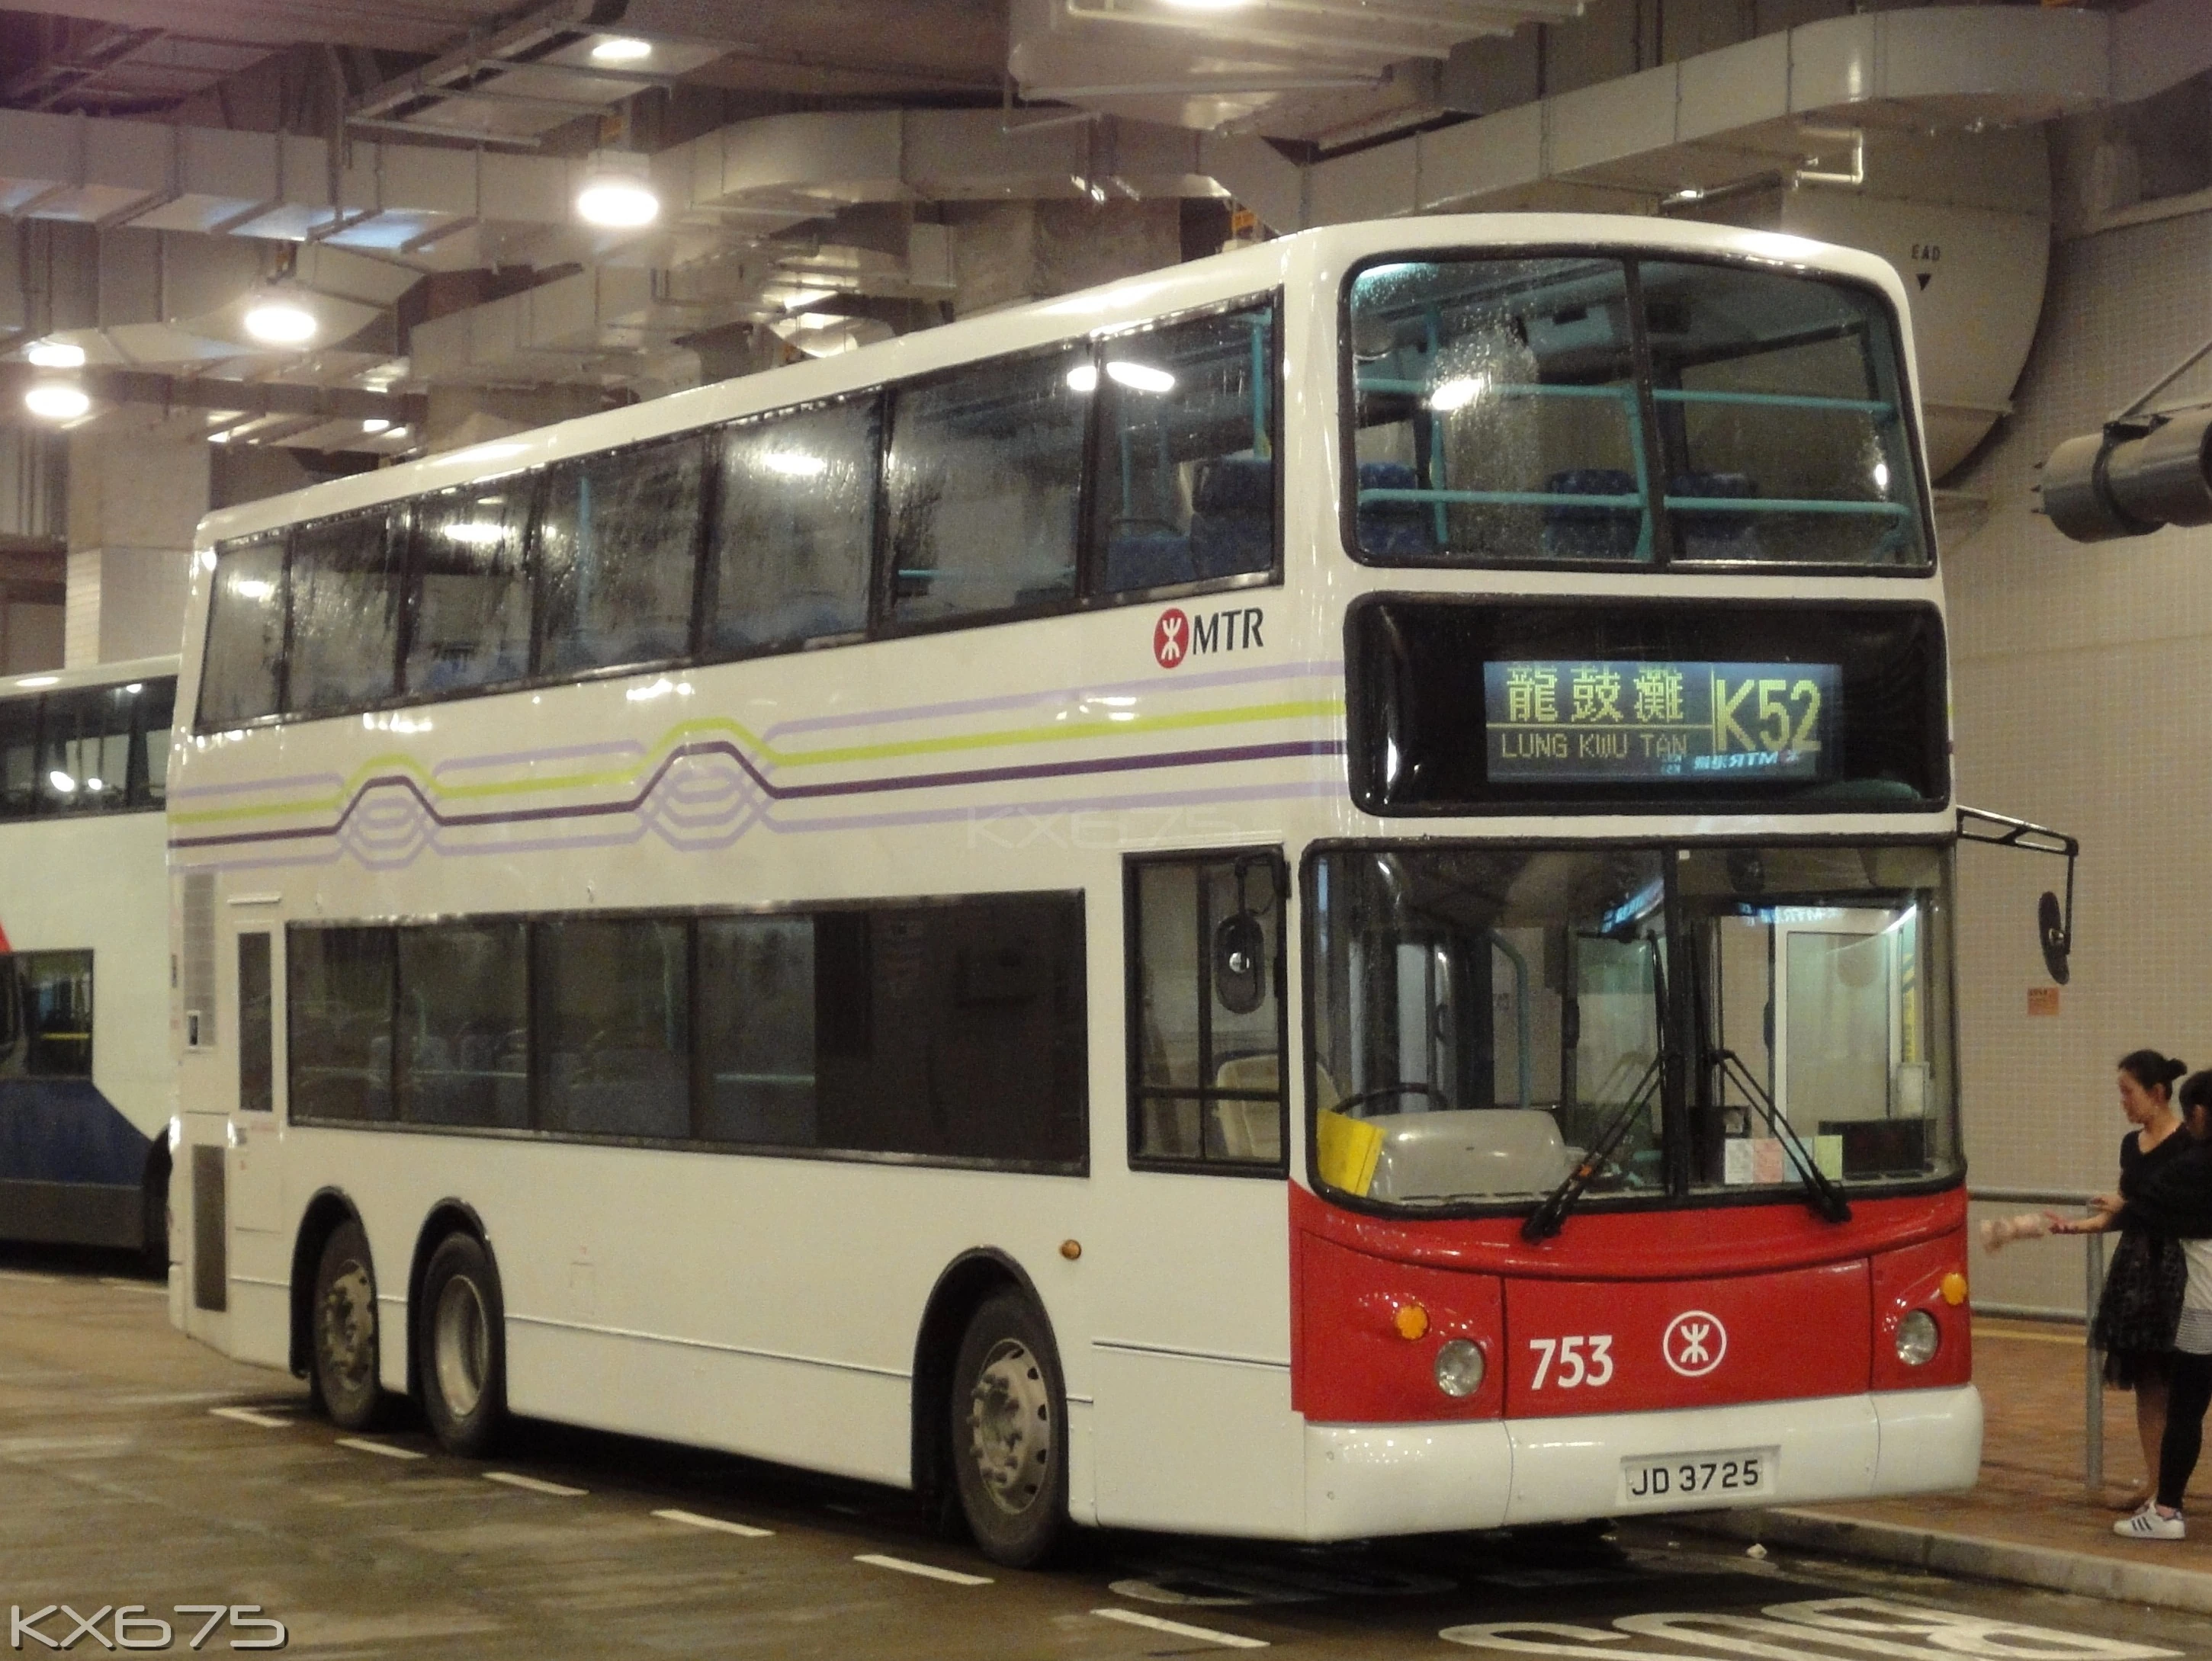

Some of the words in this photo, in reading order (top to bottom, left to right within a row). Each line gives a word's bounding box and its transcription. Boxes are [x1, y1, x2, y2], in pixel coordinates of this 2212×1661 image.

[1911, 244, 1941, 262] EAD
[1193, 608, 1264, 655] MTR
[1507, 665, 1684, 723] 龍鼓灘
[1716, 678, 1822, 752] K52
[1502, 733, 1568, 759] LUNG
[1639, 733, 1687, 759] TAN
[1530, 1335, 1613, 1390] 753
[1632, 1468, 1670, 1496] JD
[1678, 1458, 1759, 1492] 3725
